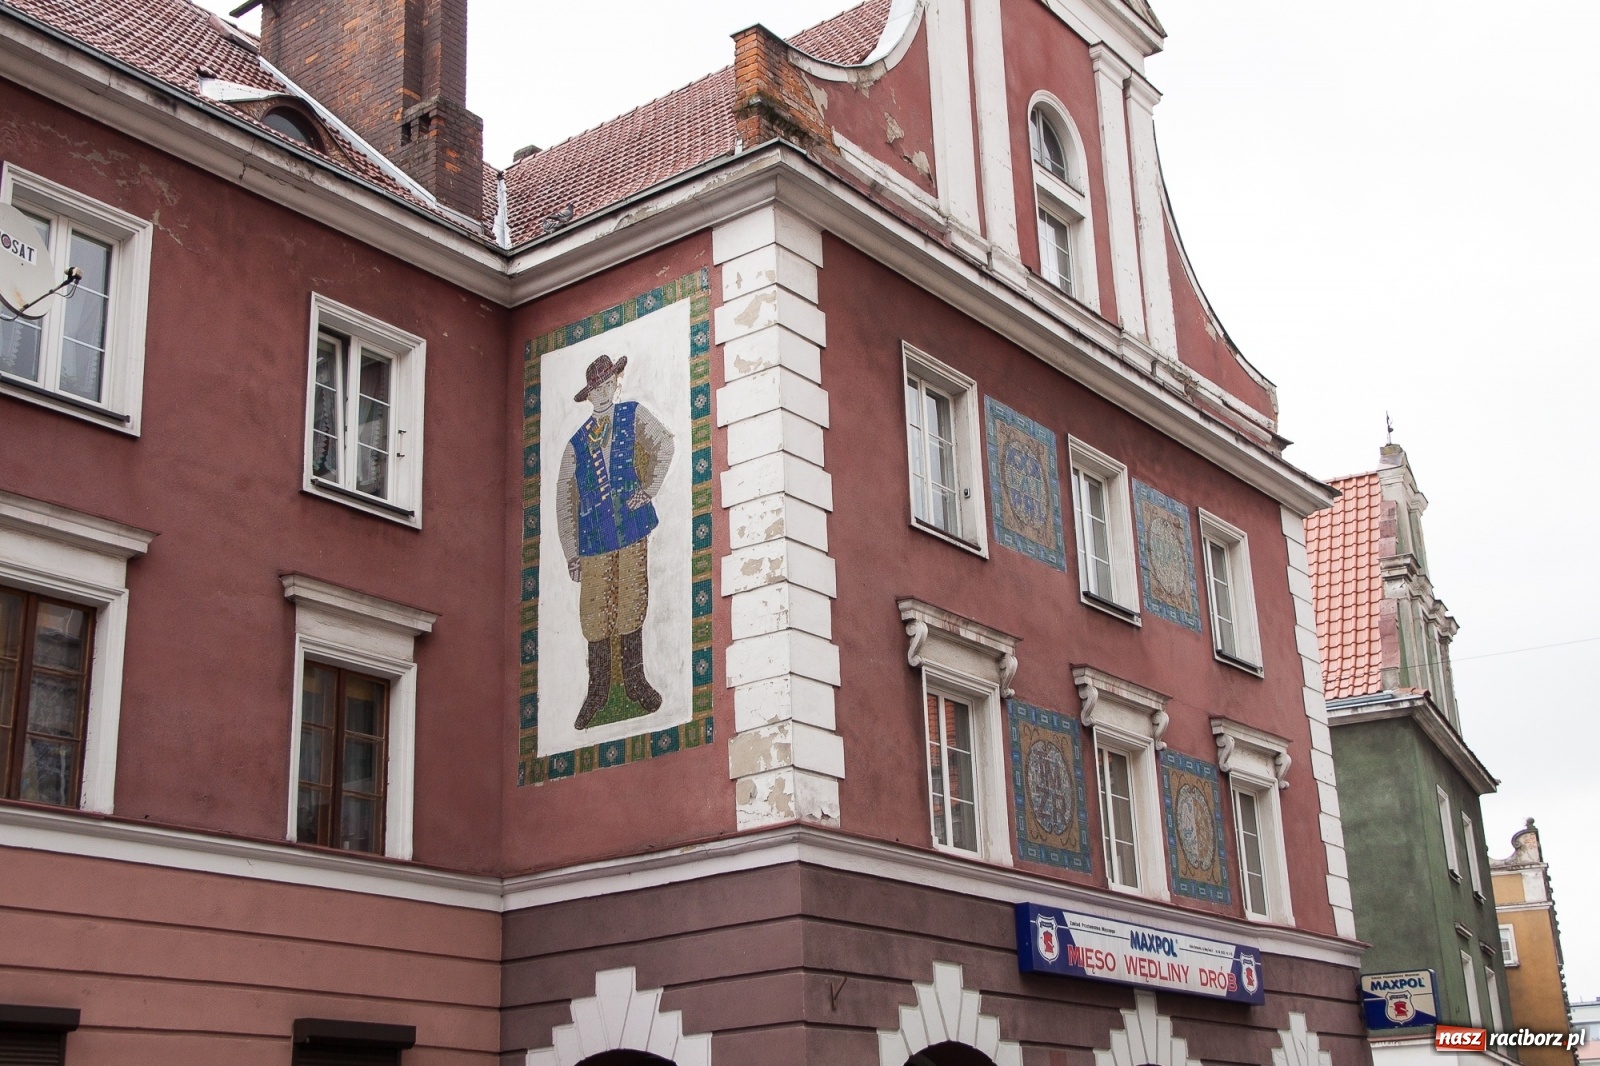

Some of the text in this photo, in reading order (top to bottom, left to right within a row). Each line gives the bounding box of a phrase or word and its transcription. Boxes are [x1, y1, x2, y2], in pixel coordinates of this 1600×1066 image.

[0, 230, 35, 262] OSAT
[1130, 929, 1177, 957] MAXPOL
[1067, 944, 1238, 992] MIĘSO WĘDLINY DRÓB
[1371, 977, 1425, 991] MAXPOL
